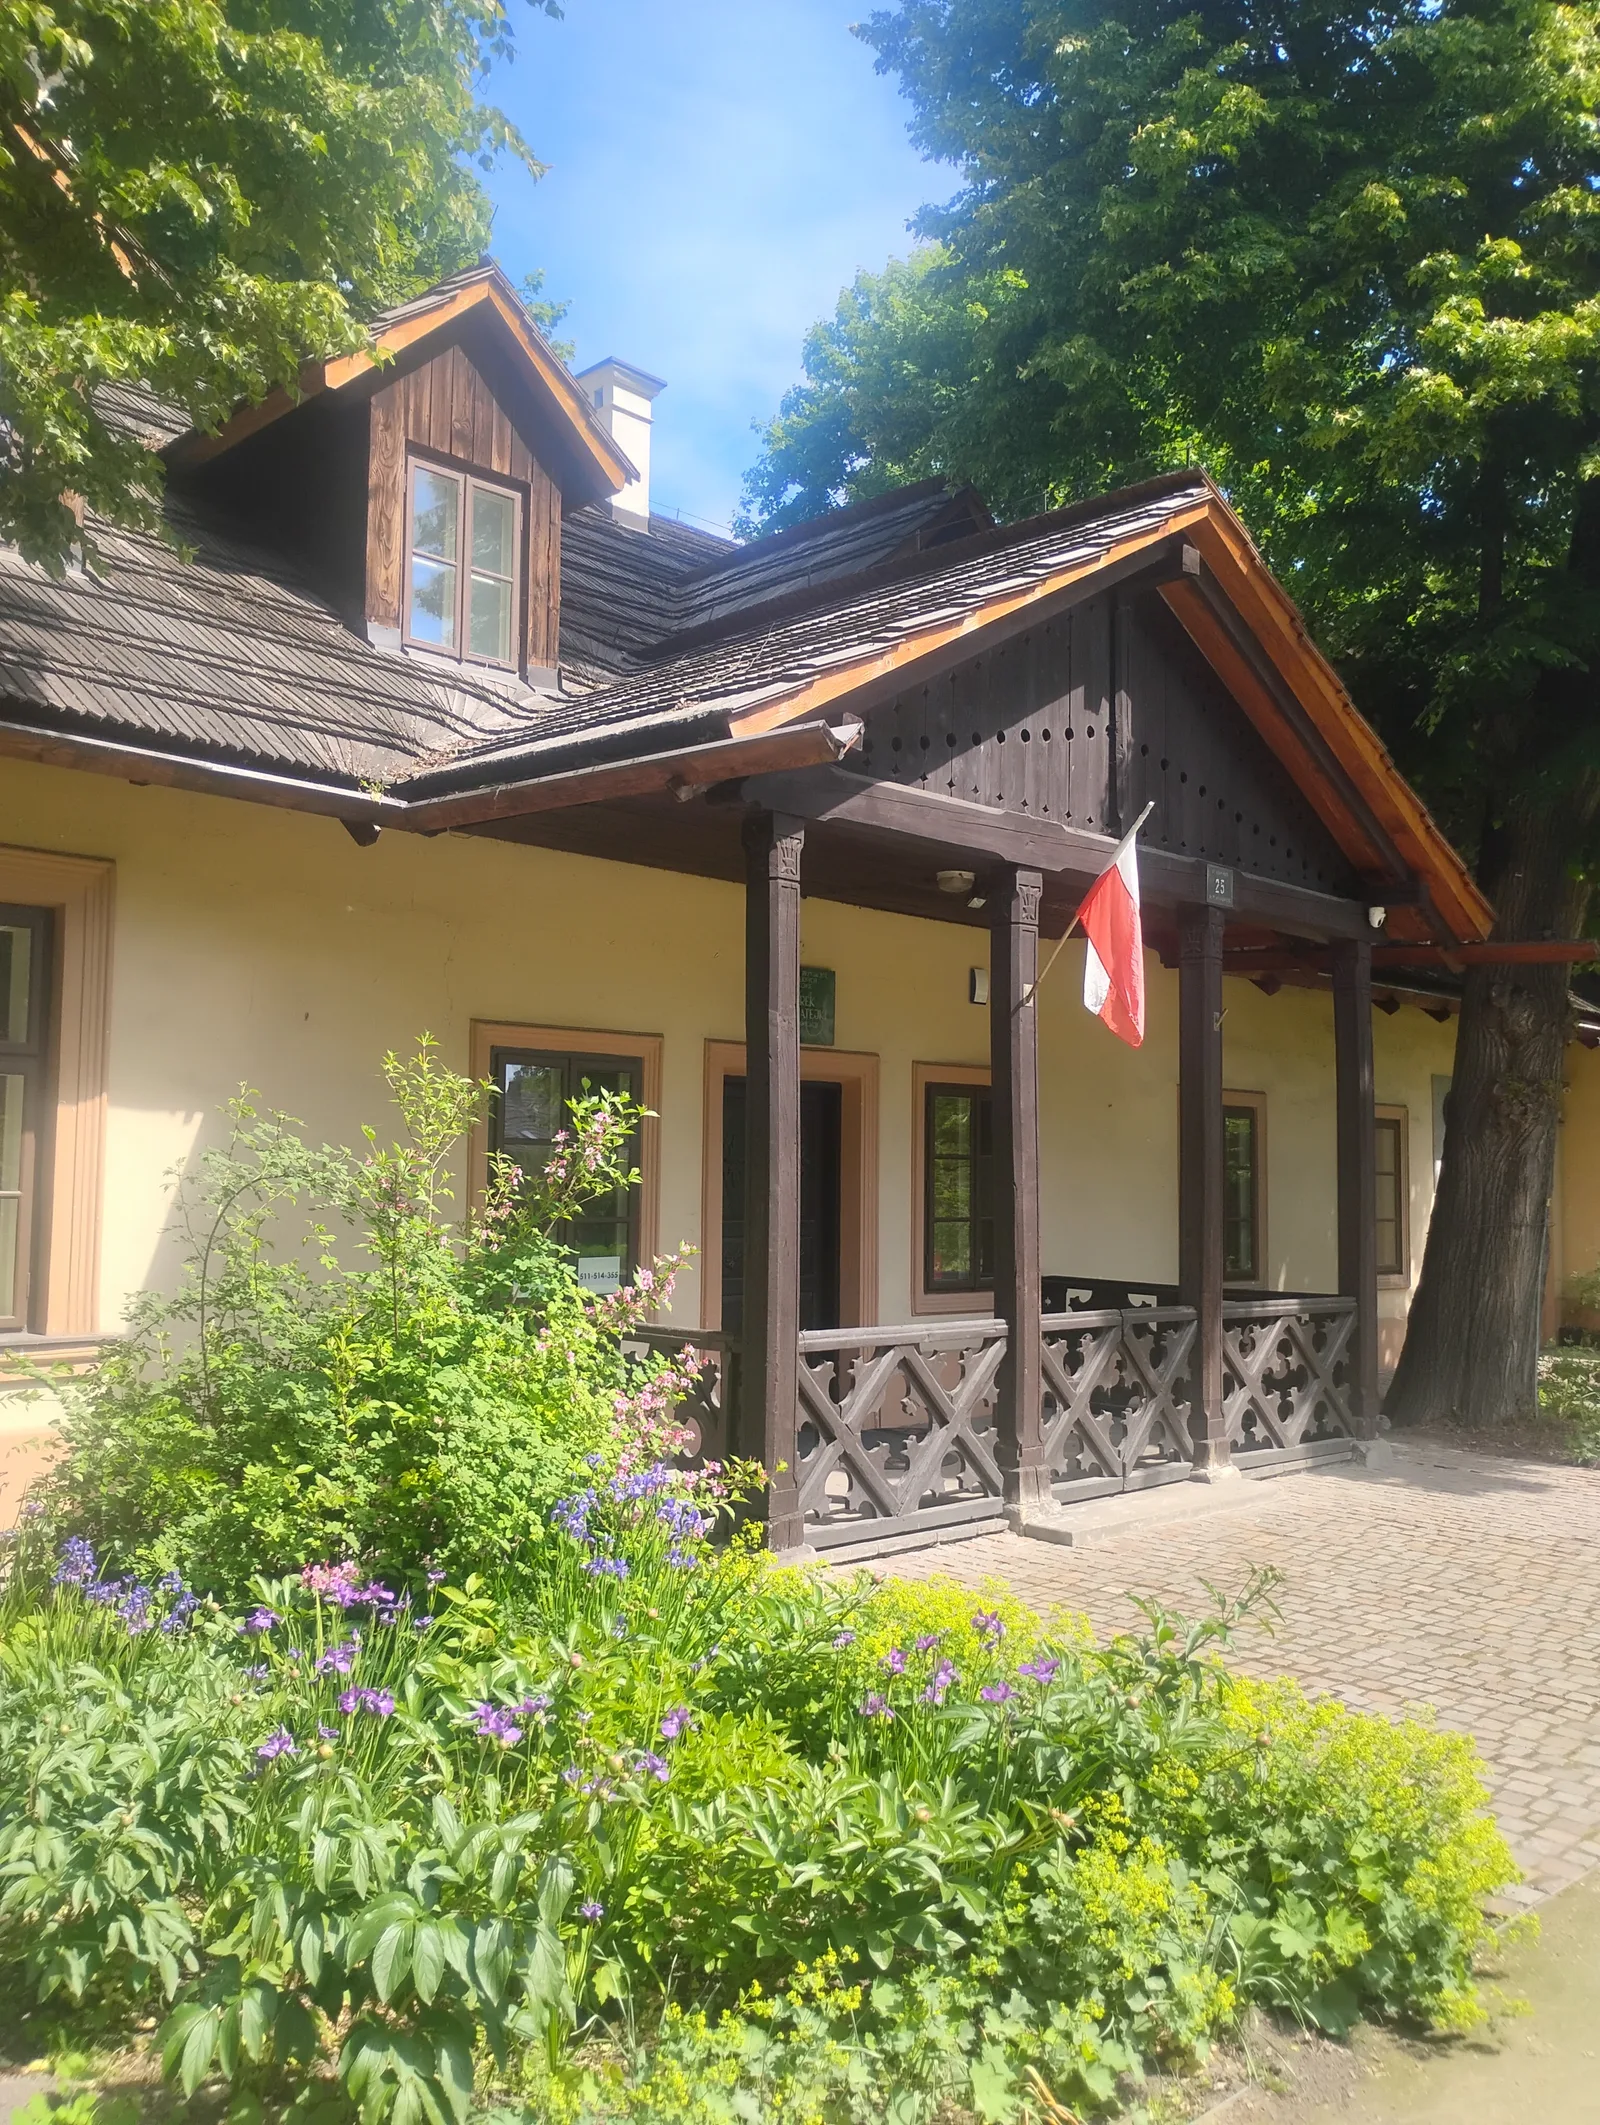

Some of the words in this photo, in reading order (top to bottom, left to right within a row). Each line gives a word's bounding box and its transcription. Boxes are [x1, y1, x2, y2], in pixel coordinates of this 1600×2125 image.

[1215, 878, 1225, 895] 25
[800, 992, 815, 1008] REK
[801, 1008, 827, 1020] ATEJKI
[579, 1271, 619, 1280] 511-514-355
